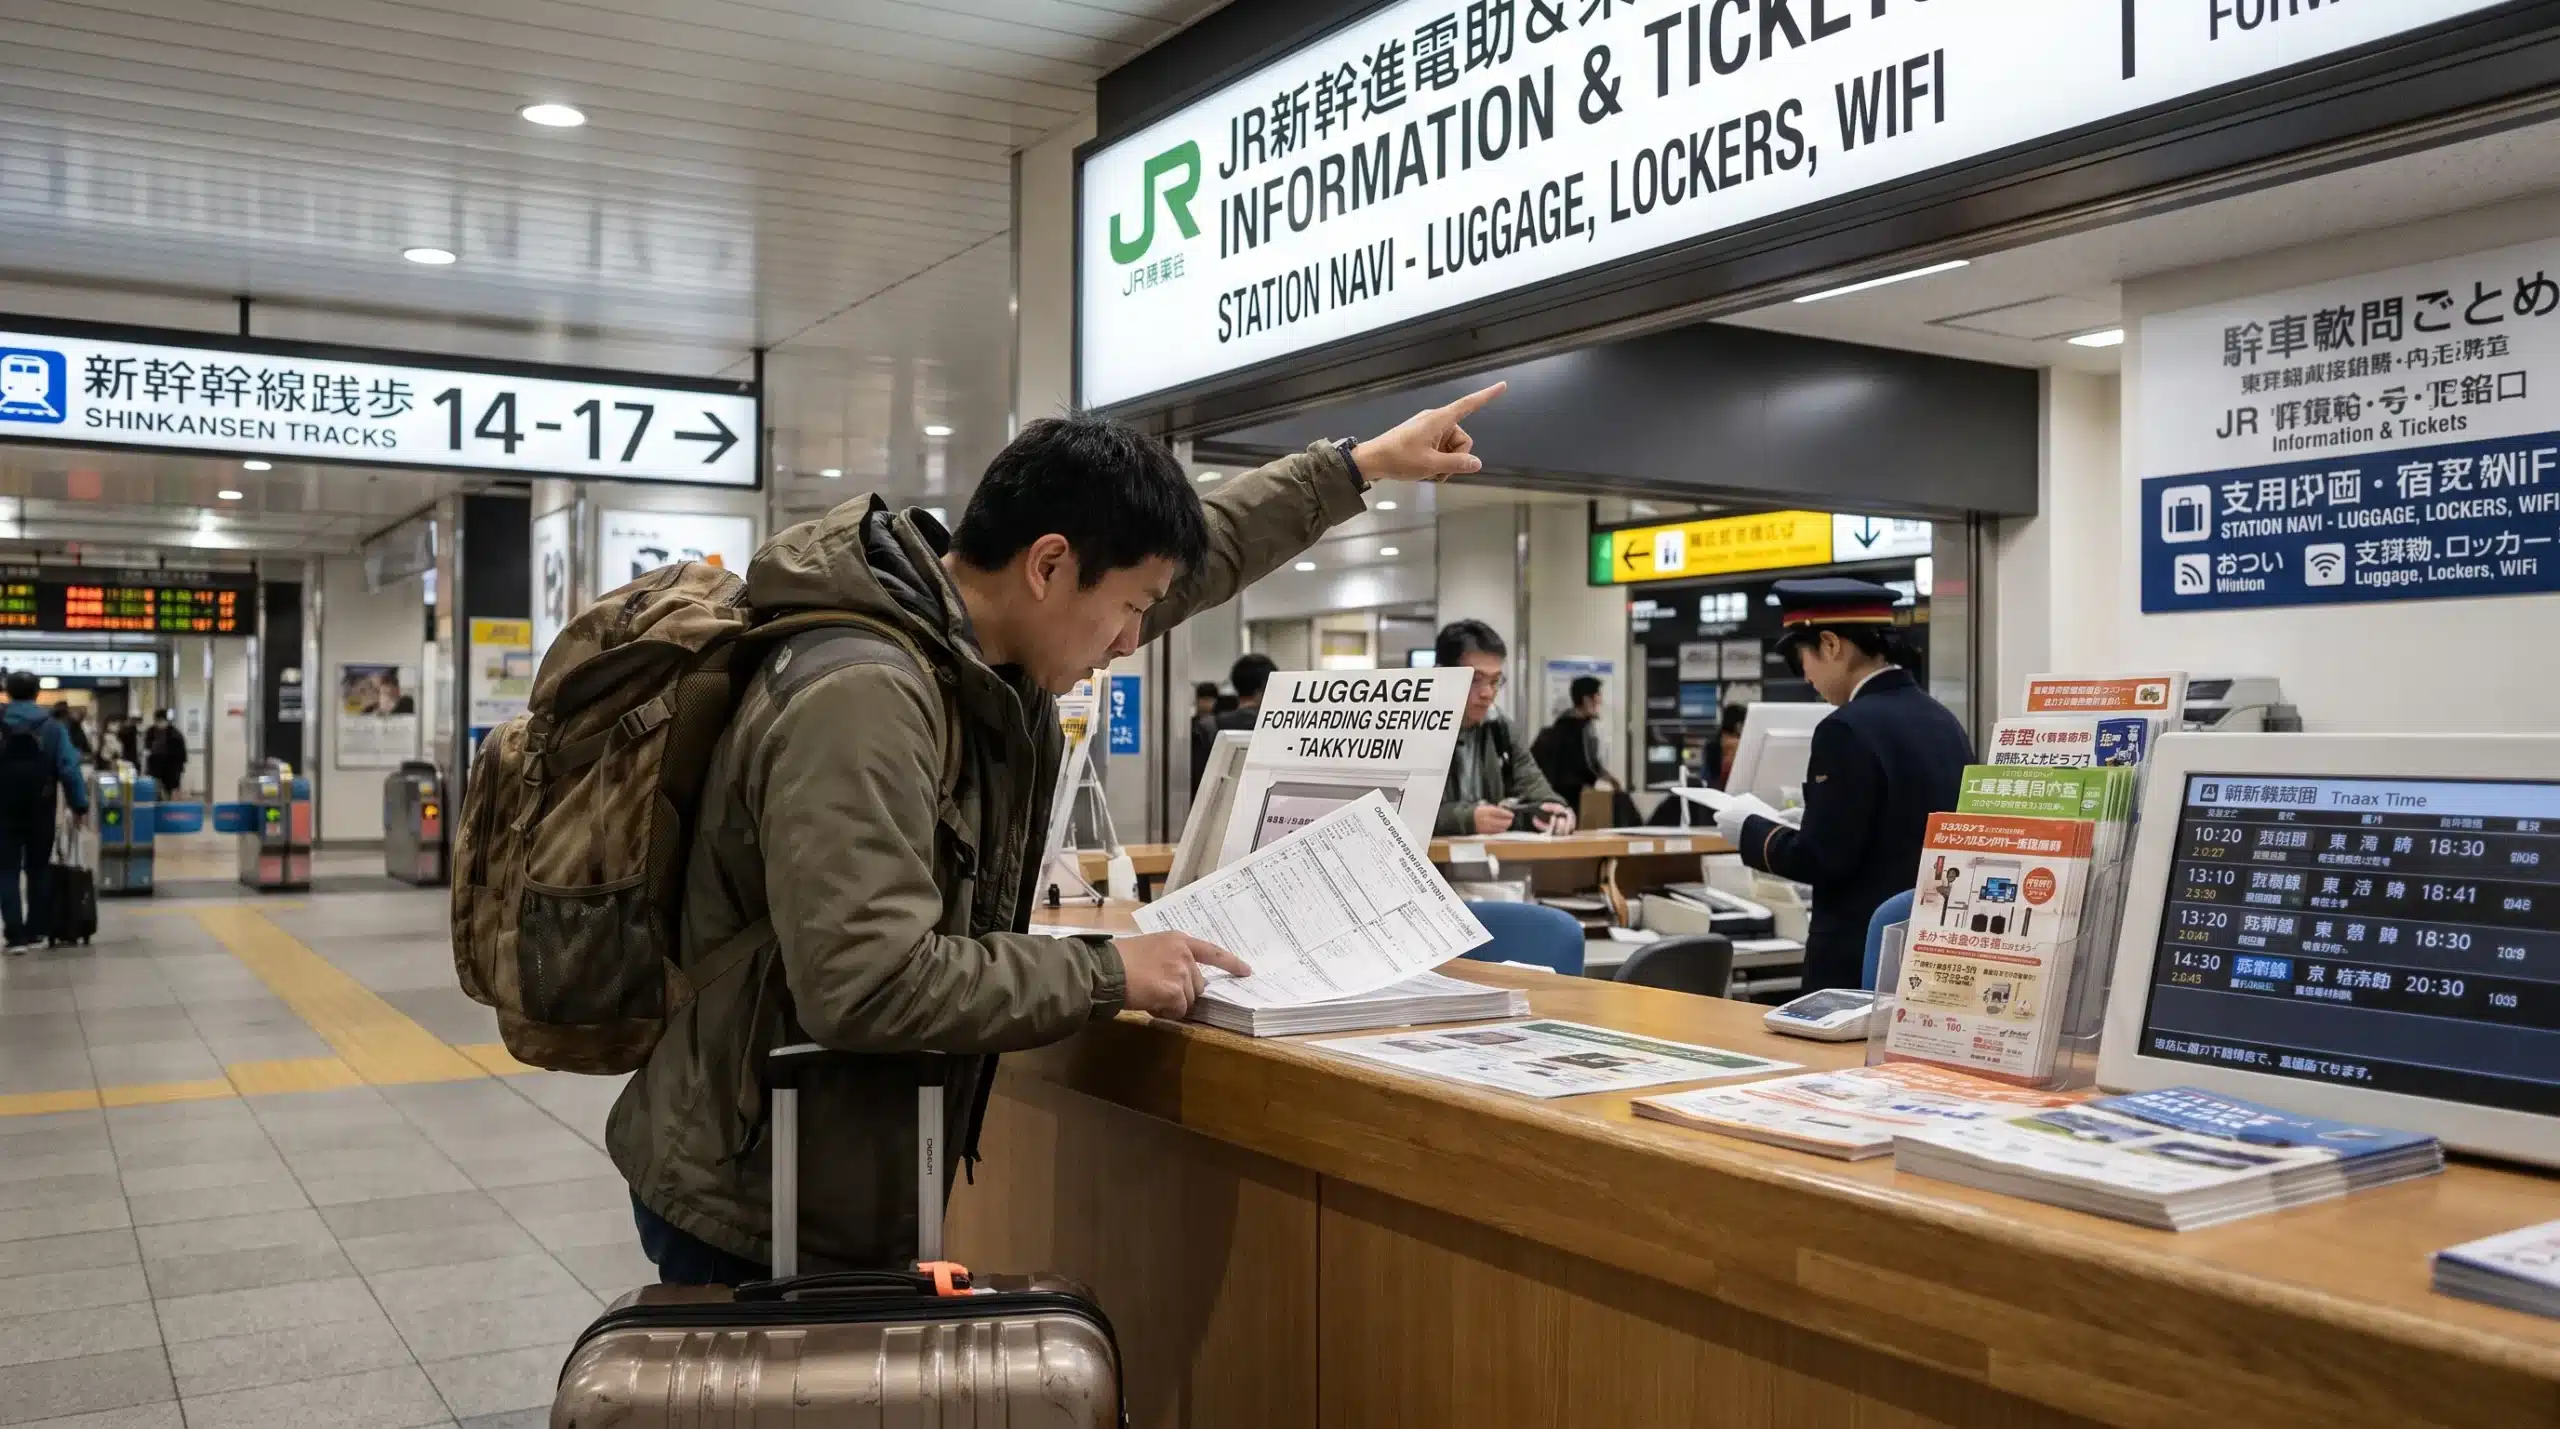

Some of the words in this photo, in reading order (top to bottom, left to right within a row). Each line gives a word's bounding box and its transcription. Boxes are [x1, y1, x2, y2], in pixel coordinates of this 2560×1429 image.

[1220, 64, 1554, 260] INFORMATION
[1578, 44, 1623, 124] &
[1110, 140, 1201, 264] JR
[1218, 262, 1320, 343] STATION
[1331, 237, 1395, 308] NAVI
[1428, 173, 1594, 280] LUGGAGE,
[1611, 98, 1817, 225] LOCKERS,
[1834, 48, 1945, 152] WIFI
[85, 407, 276, 441] SHINKANSEN
[285, 421, 398, 448] TRACKS
[433, 387, 655, 463] 14-17
[2216, 406, 2258, 439] JR
[2273, 425, 2373, 453] Information
[2380, 421, 2392, 440] &
[2399, 414, 2467, 438] Tickets
[2221, 517, 2282, 539] STATION
[2287, 514, 2322, 534] NAVI
[2338, 505, 2420, 529] LUGGAGE,
[2426, 498, 2513, 521] LOCKERS,
[2518, 492, 2559, 513] WIFI
[2355, 567, 2422, 587] Luggage,
[2428, 563, 2495, 581] Lockers,
[1292, 678, 1434, 703] LUGGAGE
[1262, 710, 1371, 729] FORWARDING
[1375, 710, 1453, 730] SERVICE
[1299, 737, 1403, 759] TAKKYUBIN
[2386, 792, 2427, 808] Time
[2195, 827, 2242, 843] 10:20
[2429, 838, 2484, 856] 18:30
[2188, 868, 2235, 885] 13:10
[2422, 883, 2476, 903] 18:41
[2180, 910, 2227, 928] 13:20
[2415, 930, 2471, 950] 18:30
[2174, 951, 2221, 970] 14:30
[2406, 976, 2464, 997] 20:30
